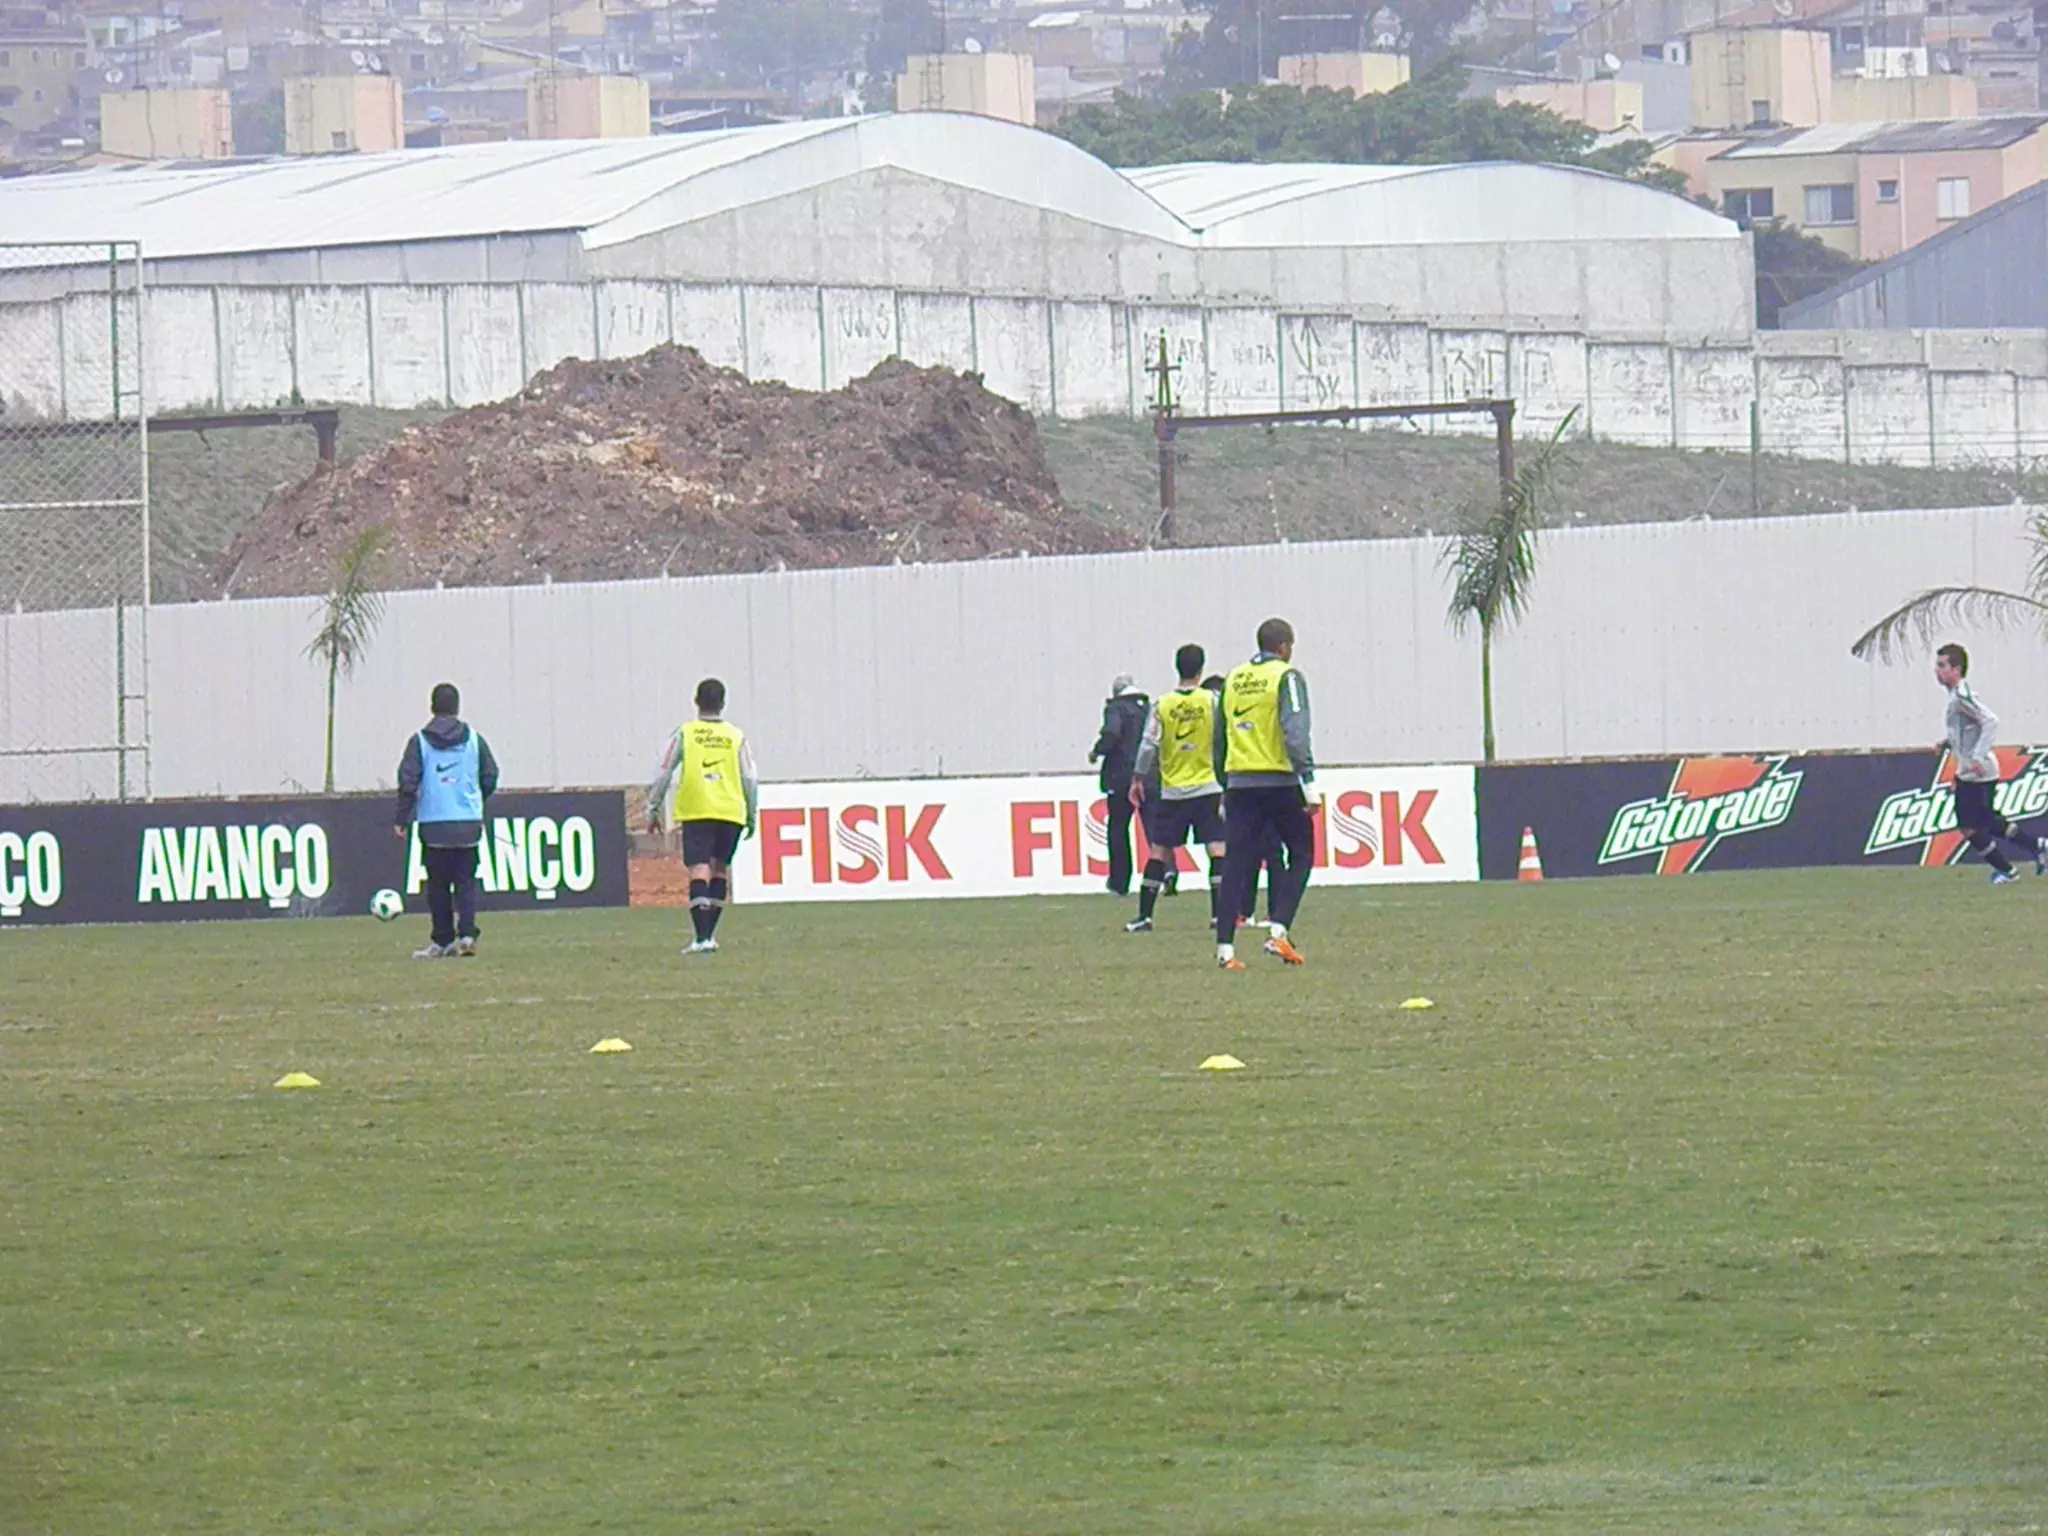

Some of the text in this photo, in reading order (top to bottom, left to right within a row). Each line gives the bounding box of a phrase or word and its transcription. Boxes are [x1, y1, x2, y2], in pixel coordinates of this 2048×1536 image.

[759, 803, 954, 885] FISK
[1312, 789, 1446, 869] ISK
[1608, 777, 1795, 856] Gatorade
[138, 823, 330, 909] AVANÇO
[407, 816, 595, 900] AANÇO
